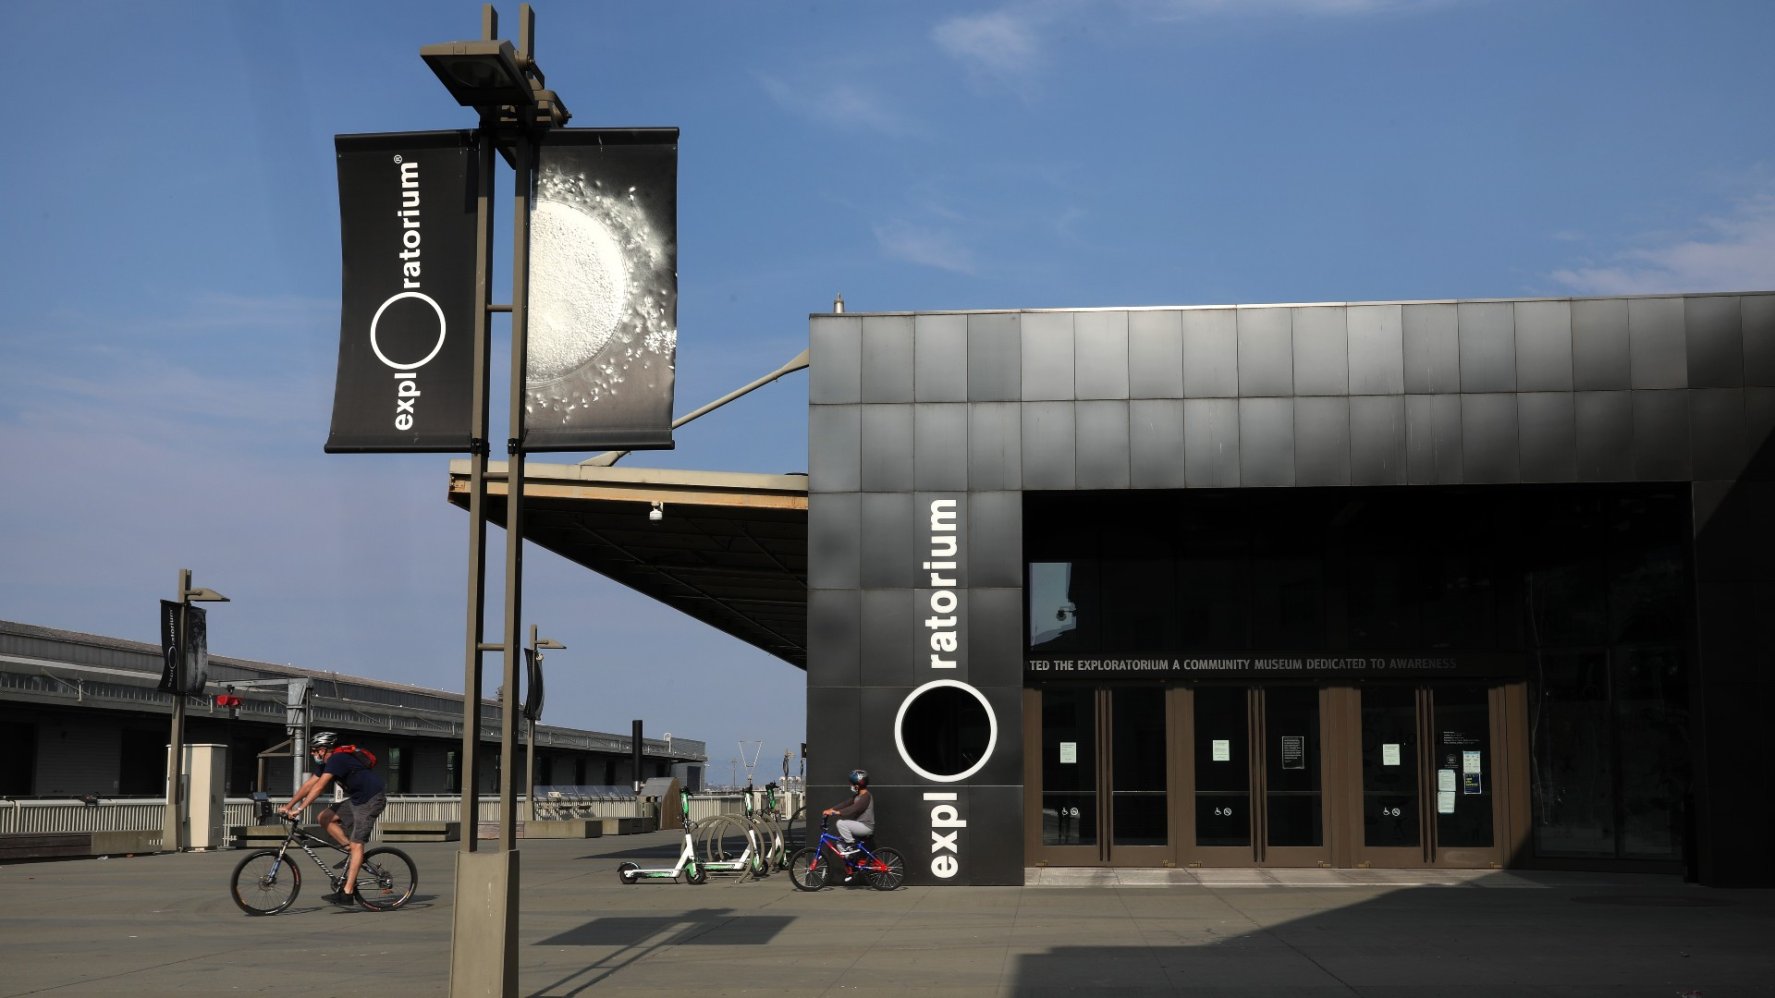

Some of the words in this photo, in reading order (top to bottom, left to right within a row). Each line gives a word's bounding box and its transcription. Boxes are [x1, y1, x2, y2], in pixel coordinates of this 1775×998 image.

[1053, 659, 1074, 671] THE
[1077, 659, 1169, 671] EXPLORATORIUM
[1172, 659, 1180, 670] A
[1183, 658, 1250, 670] COMMUNITY
[1254, 658, 1302, 670] MUSEUM
[1306, 658, 1366, 670] DEDICATED
[1370, 658, 1385, 669] TO
[1389, 658, 1456, 669] AWARENESS
